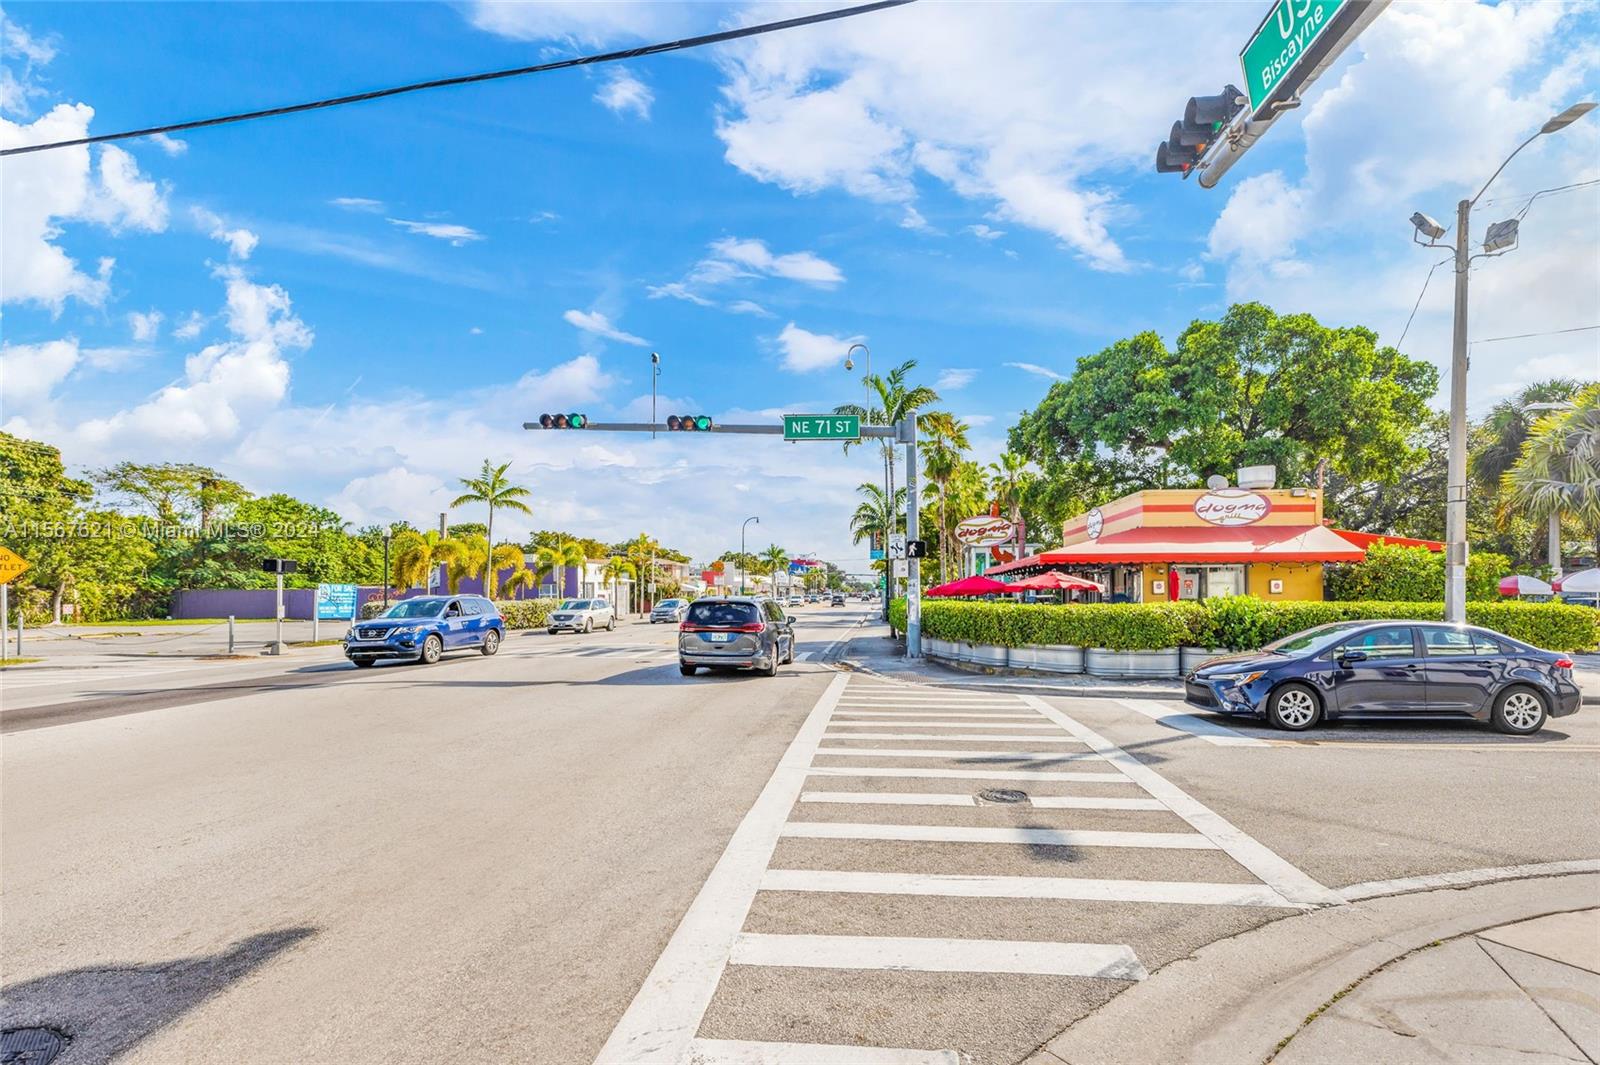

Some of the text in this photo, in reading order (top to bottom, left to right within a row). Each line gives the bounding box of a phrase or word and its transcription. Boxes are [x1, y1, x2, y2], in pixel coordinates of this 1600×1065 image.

[1262, 4, 1324, 90] Biscayne
[792, 420, 851, 434] NE 71 ST
[1197, 503, 1266, 513] dogma
[957, 523, 1012, 538] dogma
